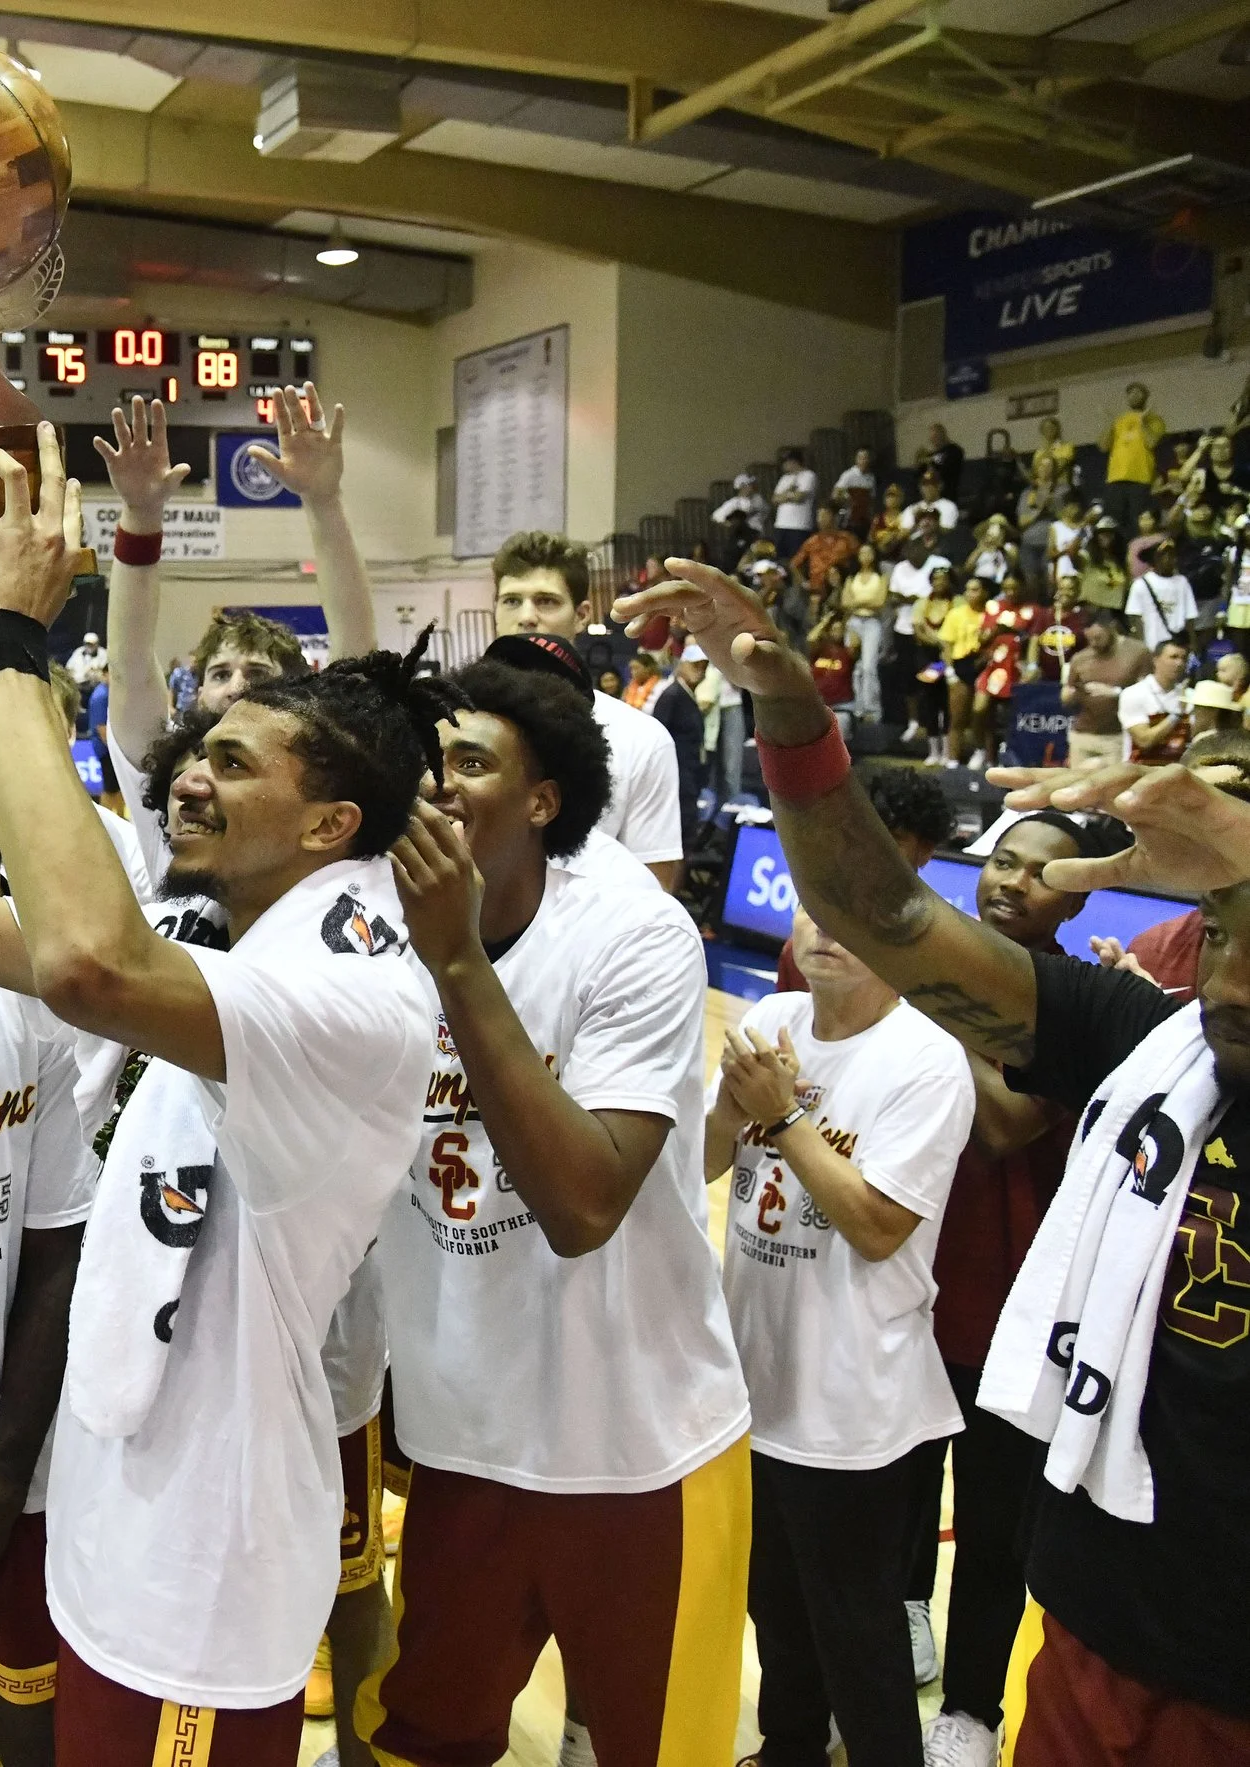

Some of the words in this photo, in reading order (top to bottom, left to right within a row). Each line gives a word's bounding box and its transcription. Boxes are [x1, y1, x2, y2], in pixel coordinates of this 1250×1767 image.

[999, 285, 1083, 329] LIVE
[46, 347, 86, 383] 75
[115, 330, 163, 366] 0.0
[198, 352, 238, 387] 88
[183, 510, 221, 523] MAUI
[428, 1131, 479, 1222] SC
[432, 1230, 500, 1256] CALIFORNIA
[452, 1227, 466, 1241] OF
[470, 1211, 536, 1240] SOUTHER
